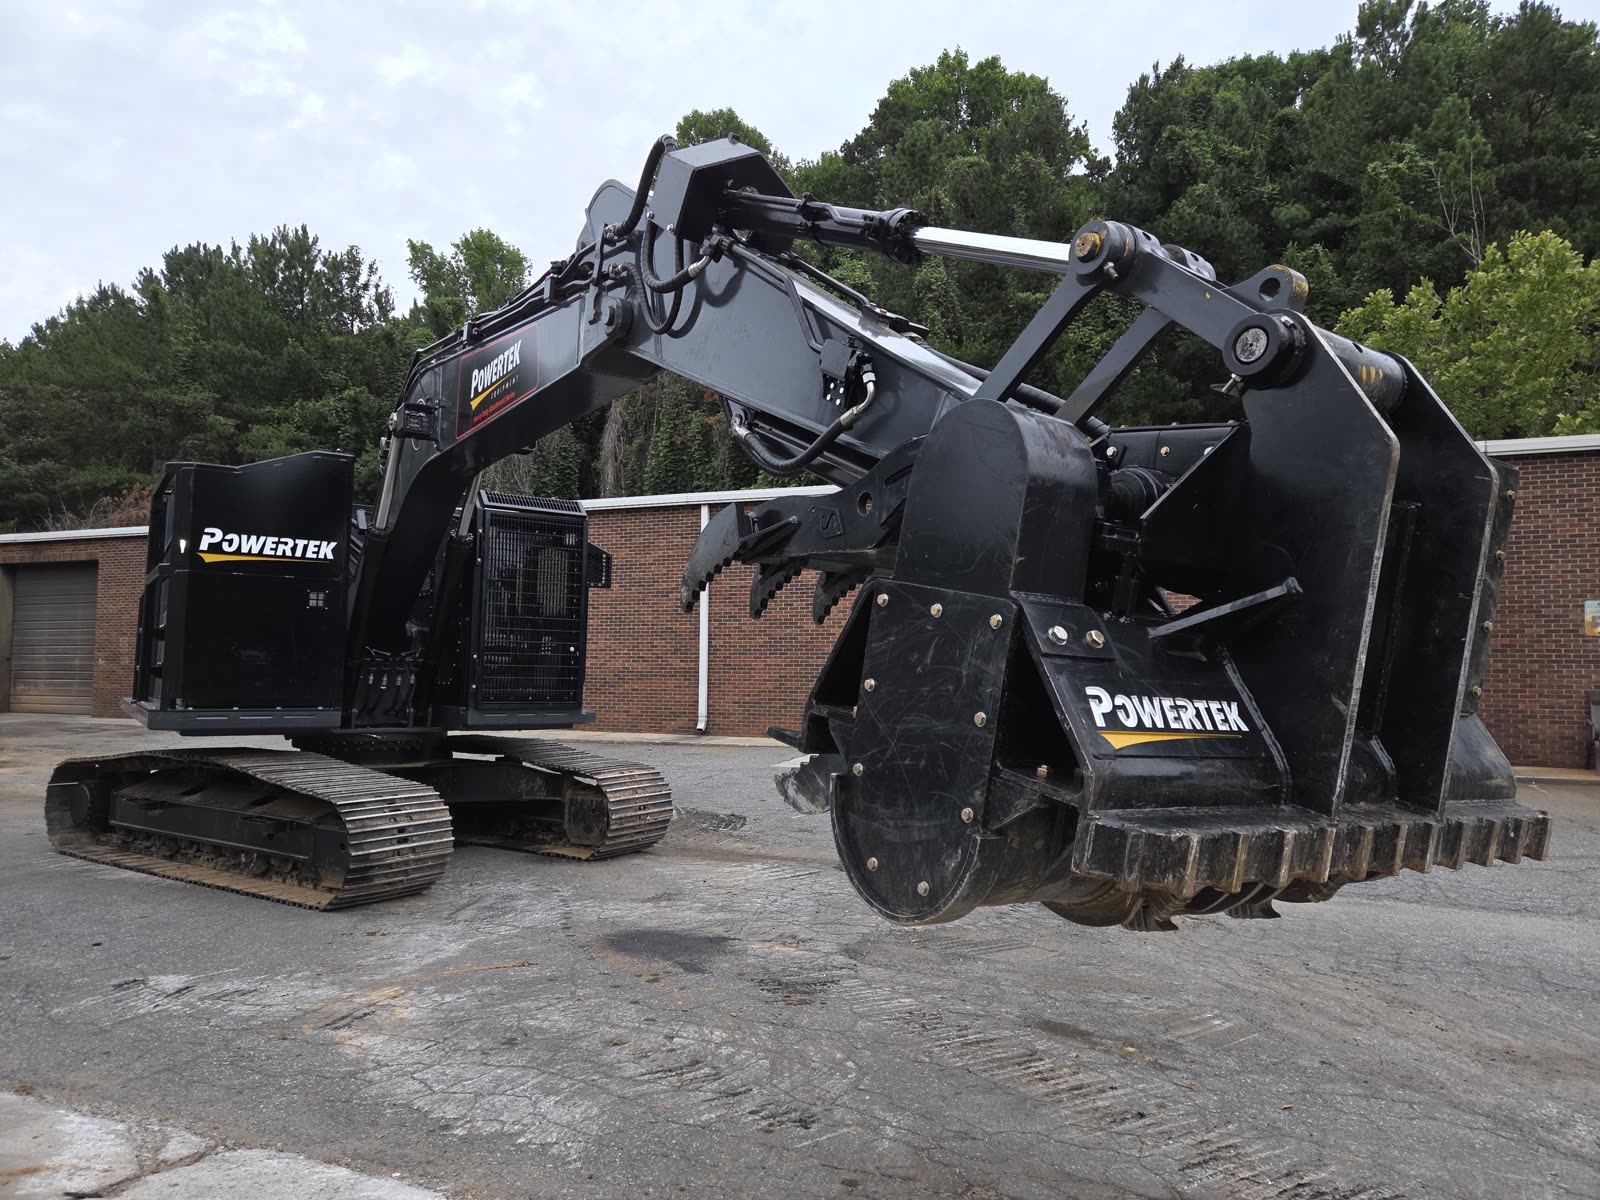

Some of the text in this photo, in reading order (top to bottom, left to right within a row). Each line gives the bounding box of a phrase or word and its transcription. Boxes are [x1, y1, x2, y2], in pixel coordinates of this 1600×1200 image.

[470, 339, 522, 399] POWERTEK
[490, 374, 519, 400] EQUIPMENT
[198, 527, 338, 560] POWERTEK
[1084, 685, 1250, 732] POWERTEK
